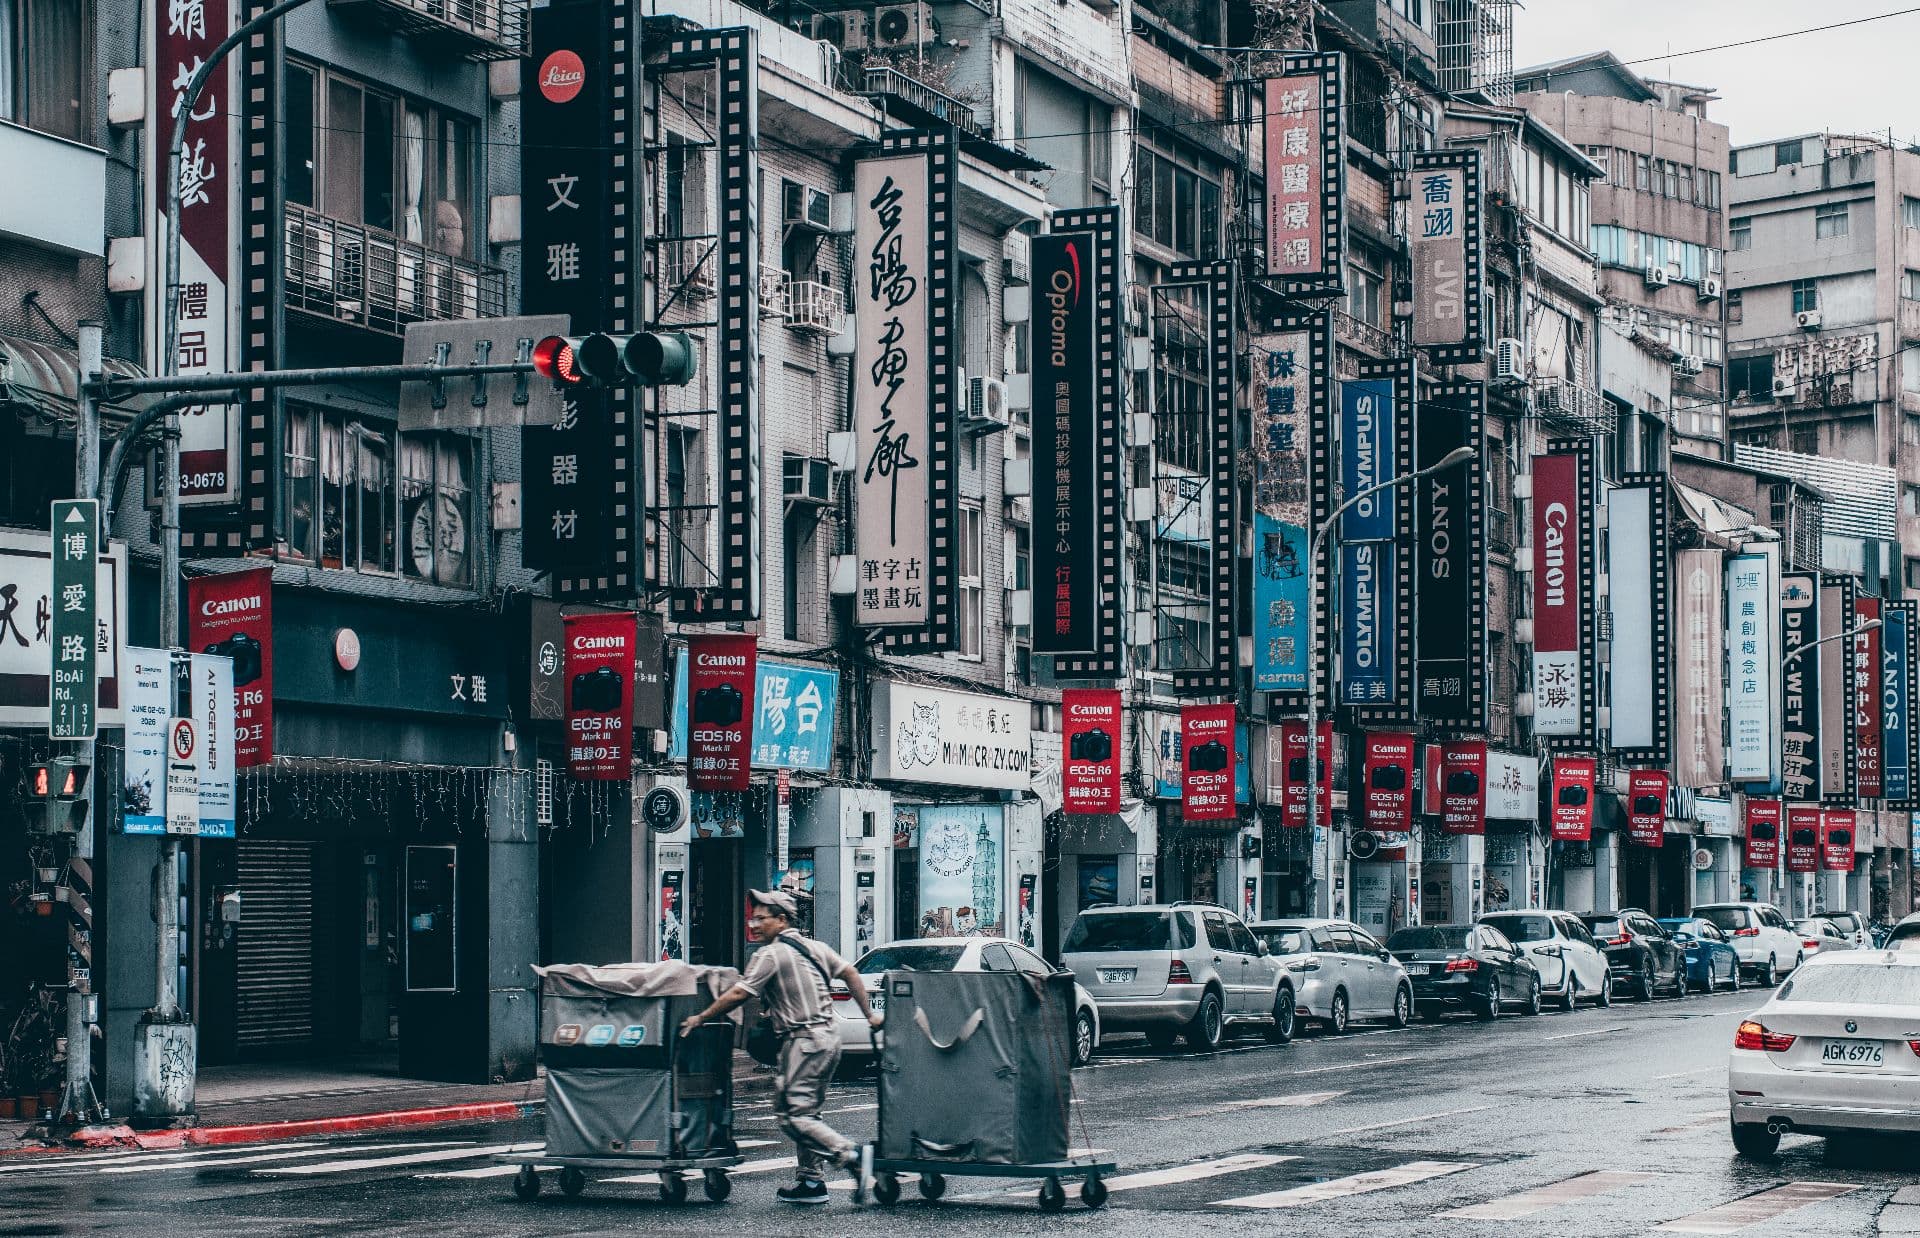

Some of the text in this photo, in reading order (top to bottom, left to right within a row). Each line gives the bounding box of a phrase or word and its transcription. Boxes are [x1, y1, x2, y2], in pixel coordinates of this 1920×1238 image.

[542, 65, 584, 86] Leica
[1281, 88, 1310, 267] 好康醫療網
[1421, 174, 1453, 237] 喬翊
[547, 174, 580, 281] 文雅
[1434, 260, 1459, 320] JVC
[1046, 269, 1074, 368] Optoma
[179, 282, 208, 416] 禮品
[1356, 394, 1373, 518] OLYMPUS
[1055, 381, 1071, 635] 奧圖碼投影機展示中心 行展國際
[1432, 479, 1449, 578] SONY
[1545, 502, 1568, 606] Canon
[62, 533, 88, 662] 博愛路
[201, 595, 262, 616] Canon
[1356, 545, 1372, 668] OLYMPUS
[573, 636, 625, 649] Canon
[1741, 601, 1757, 694] 農創概念店
[697, 654, 746, 666] Canon
[55, 669, 84, 683] BoAi
[55, 687, 74, 701] Rd.
[451, 674, 487, 703] 文雅
[1348, 681, 1387, 700] 佳美
[1423, 678, 1461, 697] 喬翊
[1884, 651, 1899, 730] SONY
[244, 690, 264, 706] R6
[60, 705, 67, 716] 2
[81, 704, 88, 716] 3
[1071, 705, 1113, 715] Canon
[55, 725, 71, 736] 36-3
[81, 724, 88, 736] 7
[208, 690, 216, 770] TOGETHER
[571, 717, 622, 731] EOS R6
[1188, 720, 1228, 729] Canon
[581, 732, 601, 741] Mark
[693, 730, 742, 742] EOS R6
[943, 741, 1028, 773] MAMACRAZY.COM
[1372, 744, 1407, 753] Canon
[1447, 752, 1480, 760] Canon
[1069, 766, 1112, 775] EOS R6
[1560, 767, 1589, 775] Canon
[1784, 739, 1801, 796] 排汗衣
[1188, 775, 1228, 785] EOS R6
[1370, 793, 1405, 802] EOS R6
[1446, 797, 1479, 806] EOS R6
[1822, 1044, 1882, 1062] AGK-6976
